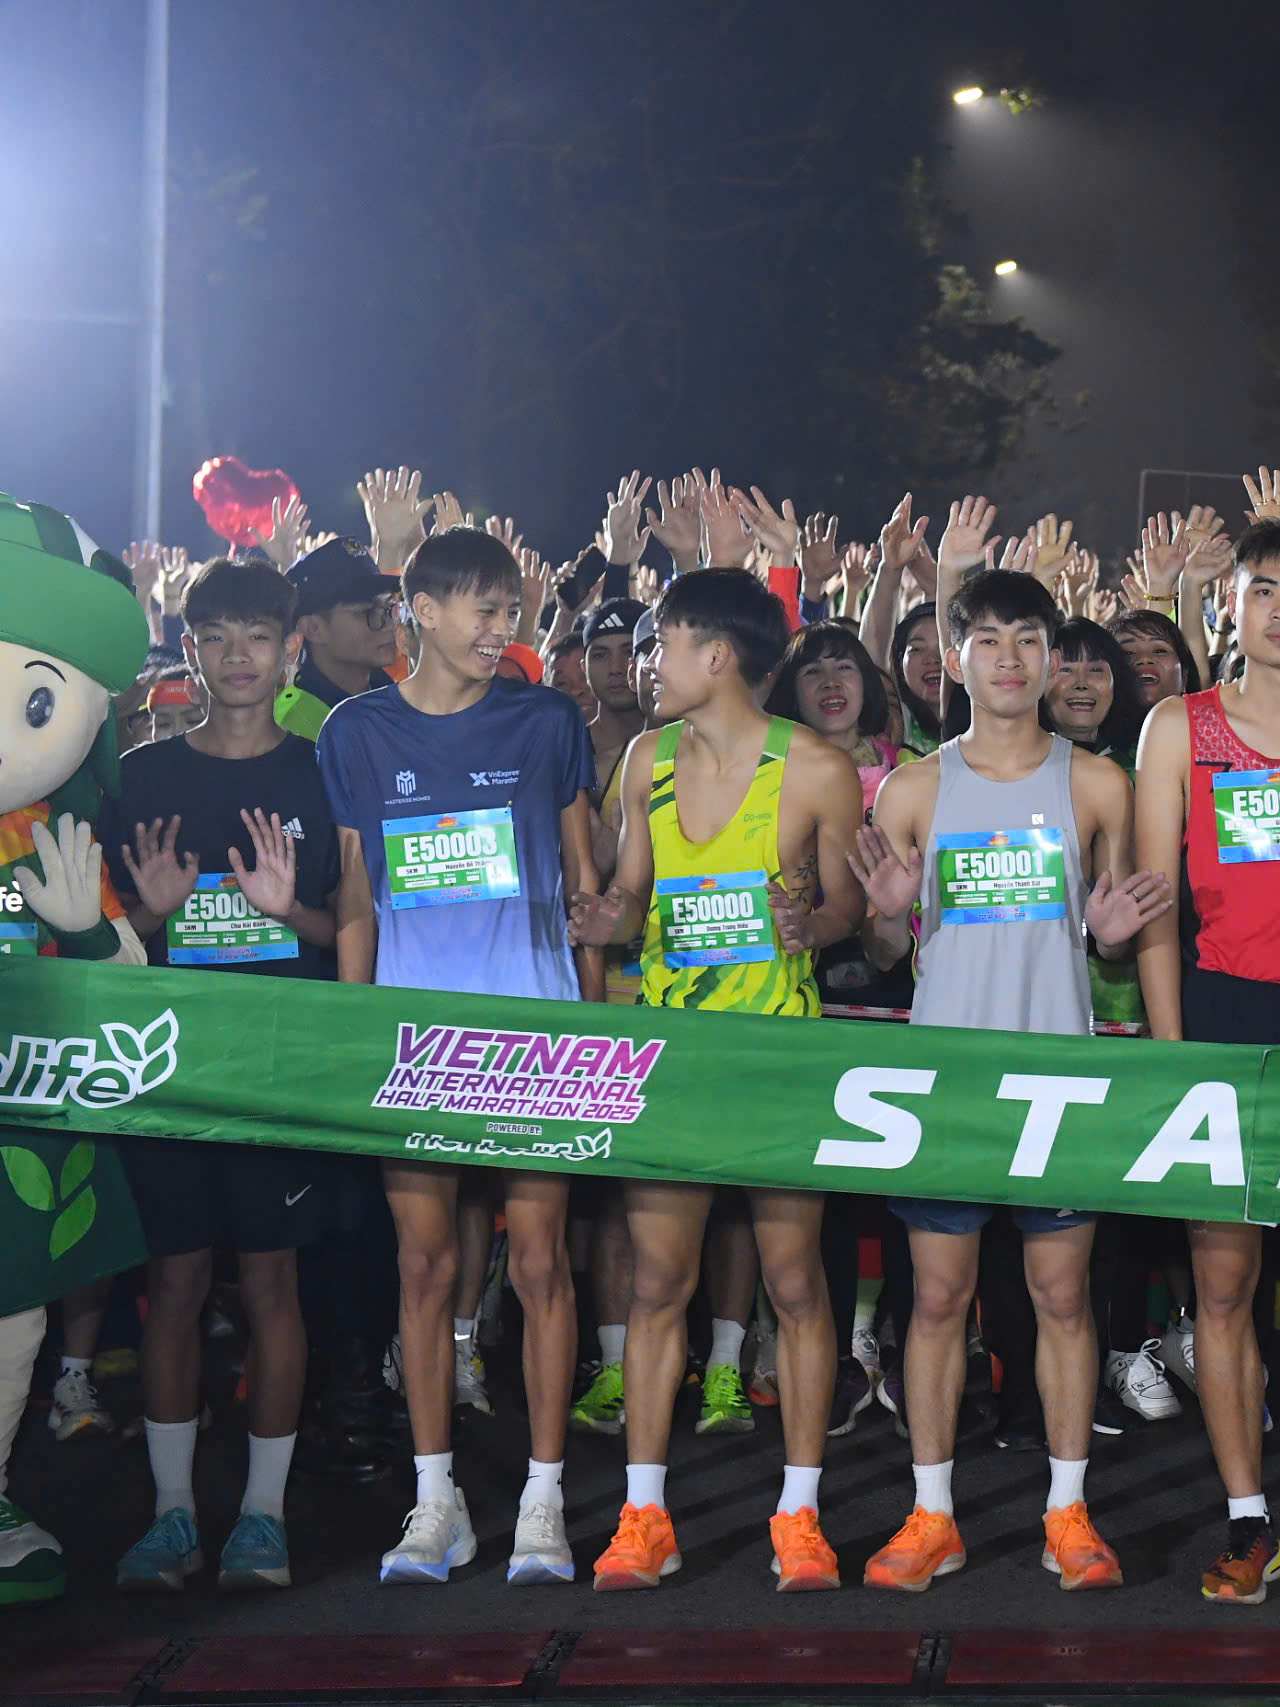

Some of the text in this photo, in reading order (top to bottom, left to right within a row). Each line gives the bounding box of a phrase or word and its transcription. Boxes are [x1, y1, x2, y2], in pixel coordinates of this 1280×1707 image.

[403, 829, 498, 864] E50003
[955, 848, 1044, 879] E50001
[184, 892, 262, 920] E500
[672, 891, 754, 924] E50000
[399, 1024, 665, 1081] VIETNAM
[0, 1035, 137, 1109] life
[387, 1067, 642, 1103] INTERNATIONAL
[375, 1089, 641, 1121] HALF MARATHON 2025
[487, 1122, 528, 1134] POWERED
